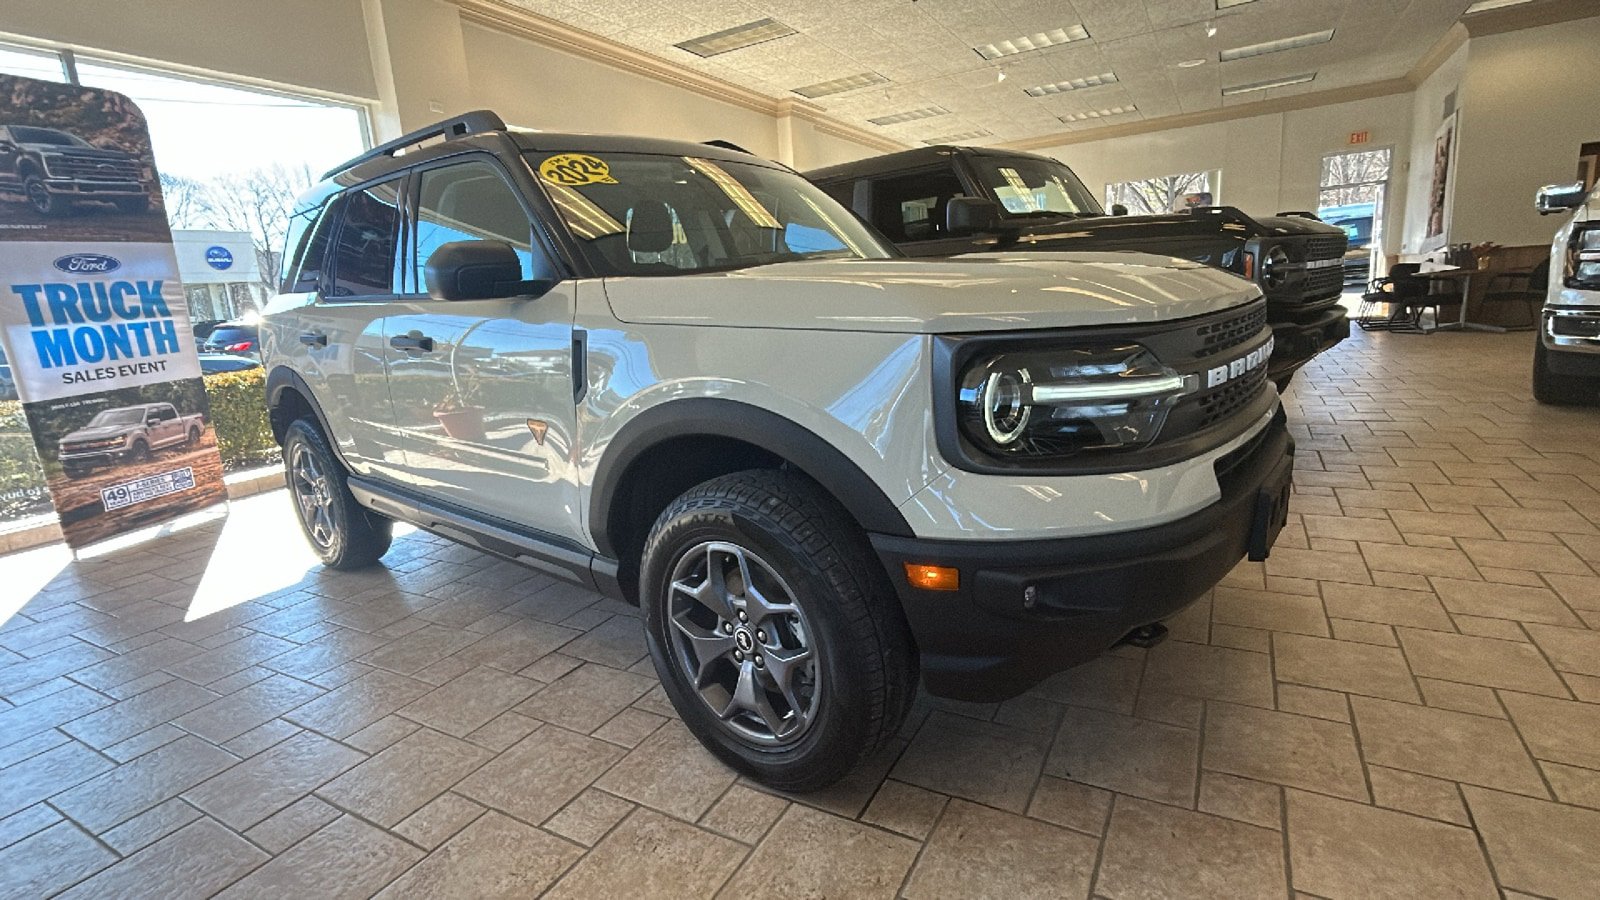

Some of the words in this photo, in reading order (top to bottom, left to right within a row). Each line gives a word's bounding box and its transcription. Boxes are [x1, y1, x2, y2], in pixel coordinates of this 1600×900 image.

[1350, 131, 1368, 144] EXIT
[546, 157, 608, 184] 2024
[67, 257, 109, 272] Ford
[11, 280, 173, 327] TRUCK
[31, 319, 181, 369] MONTH
[62, 367, 116, 384] SALES
[119, 360, 167, 377] EVENT
[107, 488, 127, 501] 49
